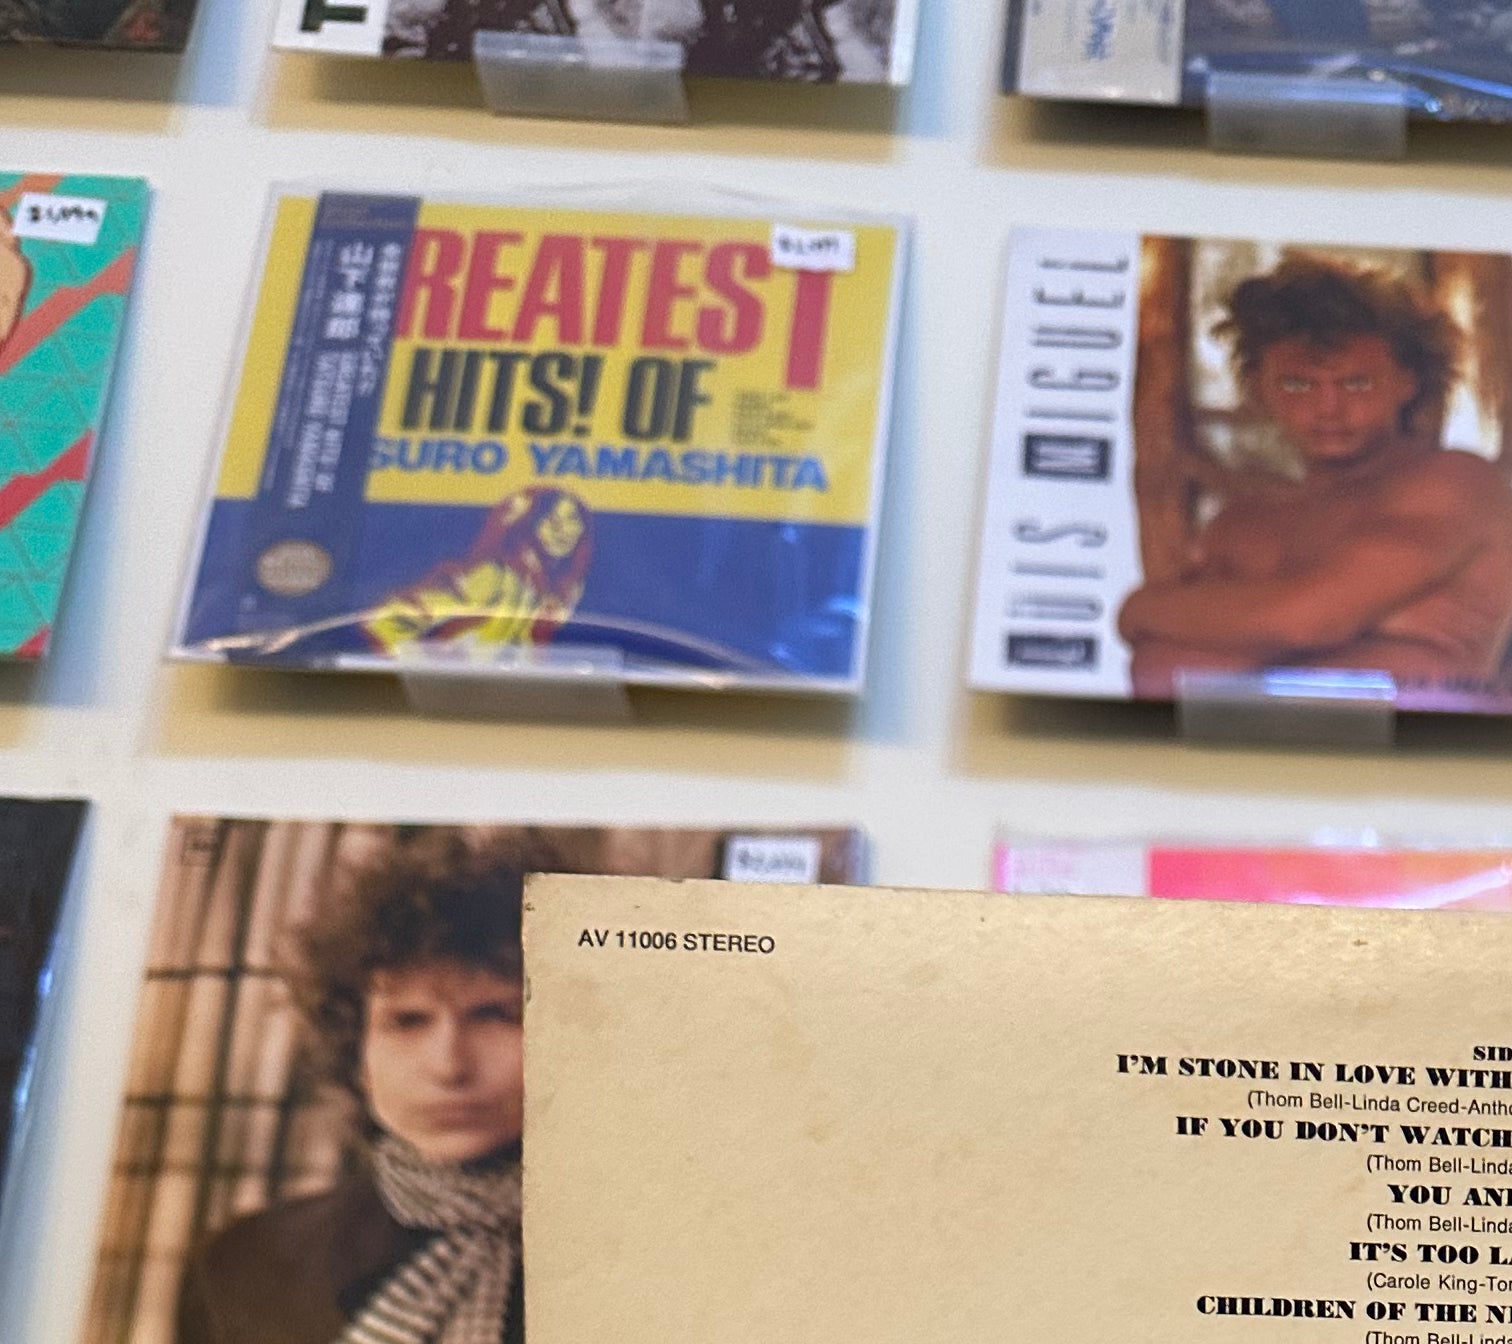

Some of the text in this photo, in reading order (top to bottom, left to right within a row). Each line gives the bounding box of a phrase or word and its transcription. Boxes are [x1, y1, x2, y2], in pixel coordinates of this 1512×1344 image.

[396, 227, 832, 390] REATEST
[402, 348, 604, 437] HITS!
[622, 356, 717, 442] OF
[371, 437, 830, 491] SURO YAMASHITA
[1007, 258, 1130, 671] LUIS MIGUEL
[578, 929, 775, 954] AV 11006 STEREO
[1116, 1054, 1168, 1075] I'M
[1178, 1057, 1279, 1080] STONE
[1290, 1062, 1325, 1082] IN
[1335, 1064, 1415, 1085] LOVE
[1426, 1067, 1512, 1089] WITH
[1248, 1090, 1303, 1109] (Thom
[1310, 1092, 1400, 1112] Bell-Linda
[1176, 1116, 1208, 1136] IF
[1218, 1118, 1284, 1140] YOU
[1295, 1120, 1390, 1143] DON'T
[1387, 1184, 1452, 1205] YOU
[1349, 1242, 1407, 1262] IT'S
[1417, 1244, 1479, 1264] TOO
[1367, 1272, 1430, 1292] (Carole
[1197, 1296, 1356, 1319] CHILDREN
[1366, 1301, 1406, 1320] OF
[1414, 1302, 1476, 1323] THE
